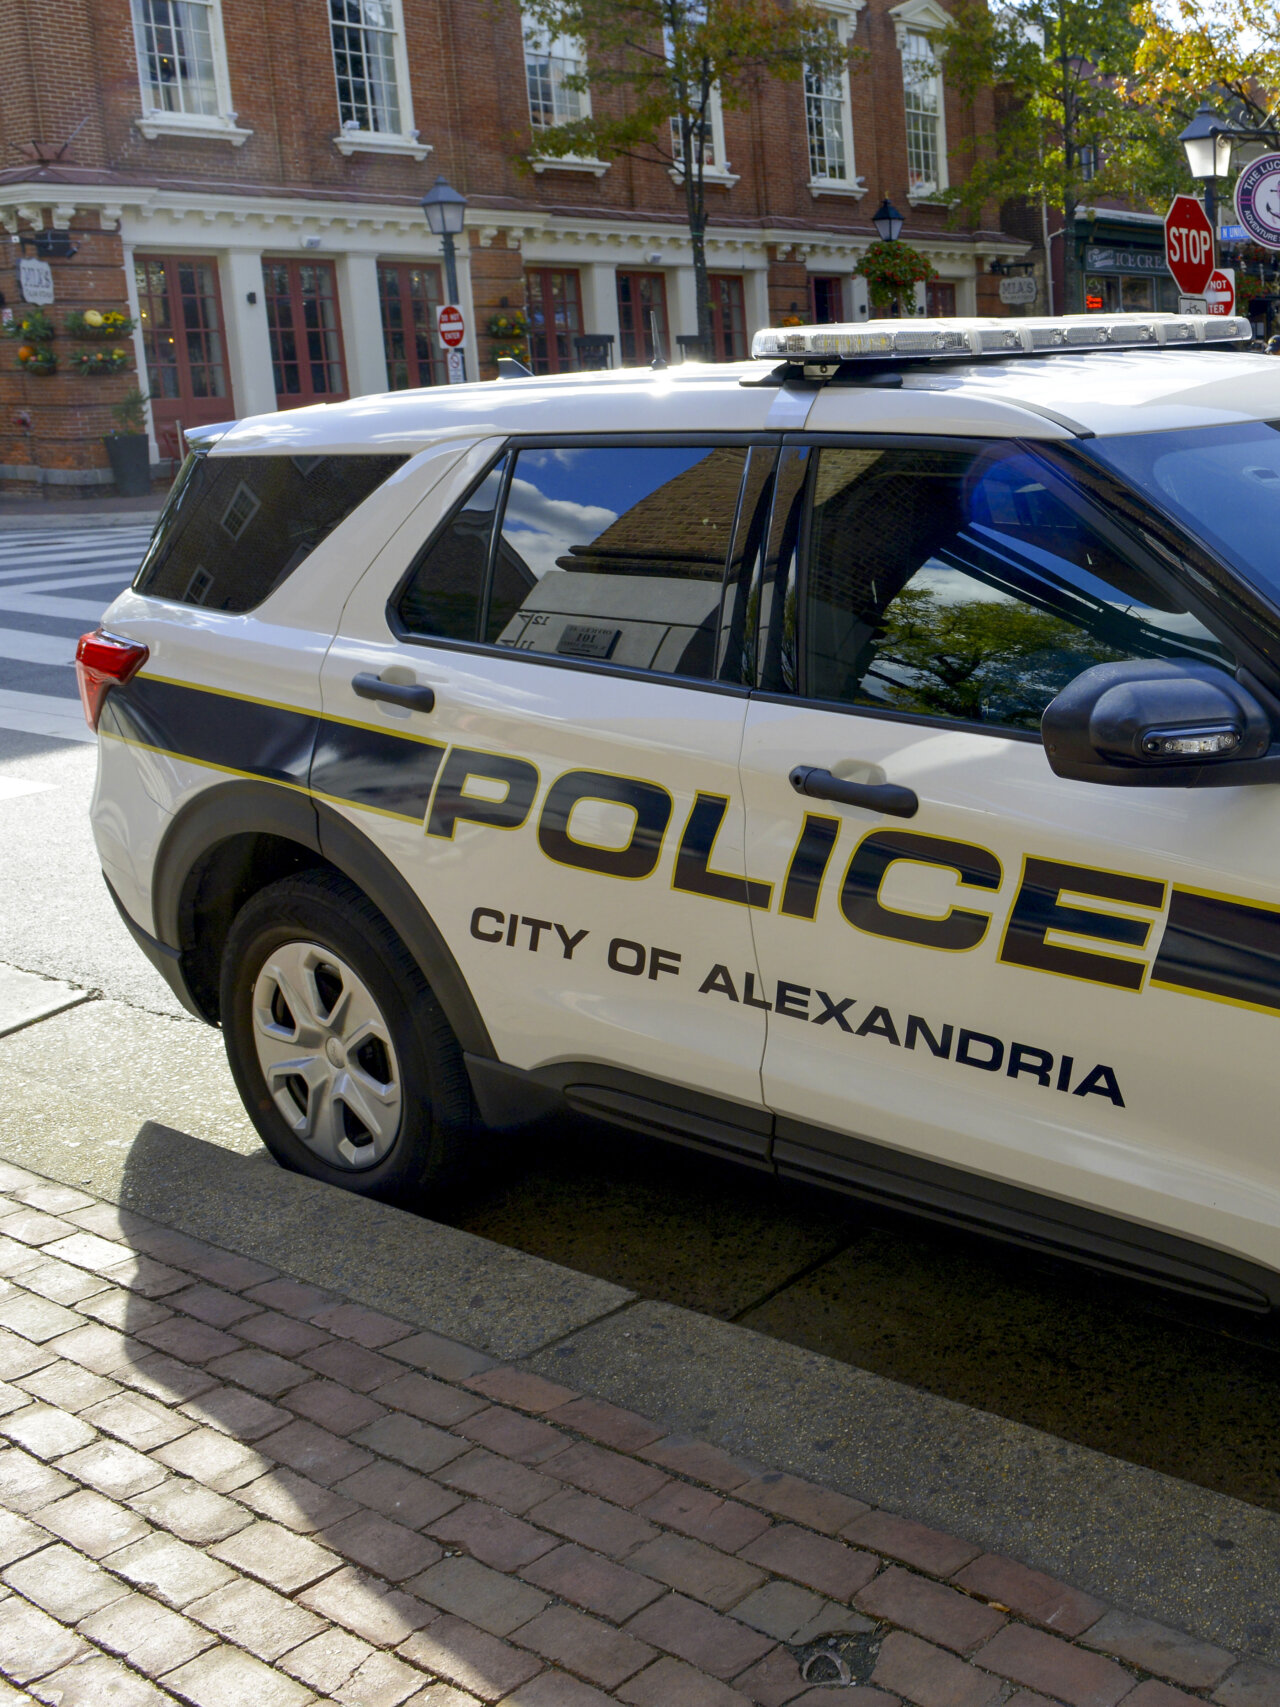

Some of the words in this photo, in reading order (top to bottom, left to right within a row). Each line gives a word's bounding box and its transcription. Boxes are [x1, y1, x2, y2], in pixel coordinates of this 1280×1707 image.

[1244, 170, 1261, 190] THE
[1244, 210, 1278, 242] ADVENTURE
[1169, 226, 1211, 265] STOP
[1116, 252, 1136, 268] ICE
[1210, 279, 1227, 290] NOT
[1208, 303, 1225, 314] TER
[441, 314, 448, 322] DO
[444, 332, 460, 340] ENTER
[425, 742, 1169, 994] POLICE
[469, 906, 589, 961] CITY
[607, 938, 682, 982] OF
[699, 963, 1126, 1109] ALEXANDRIA
